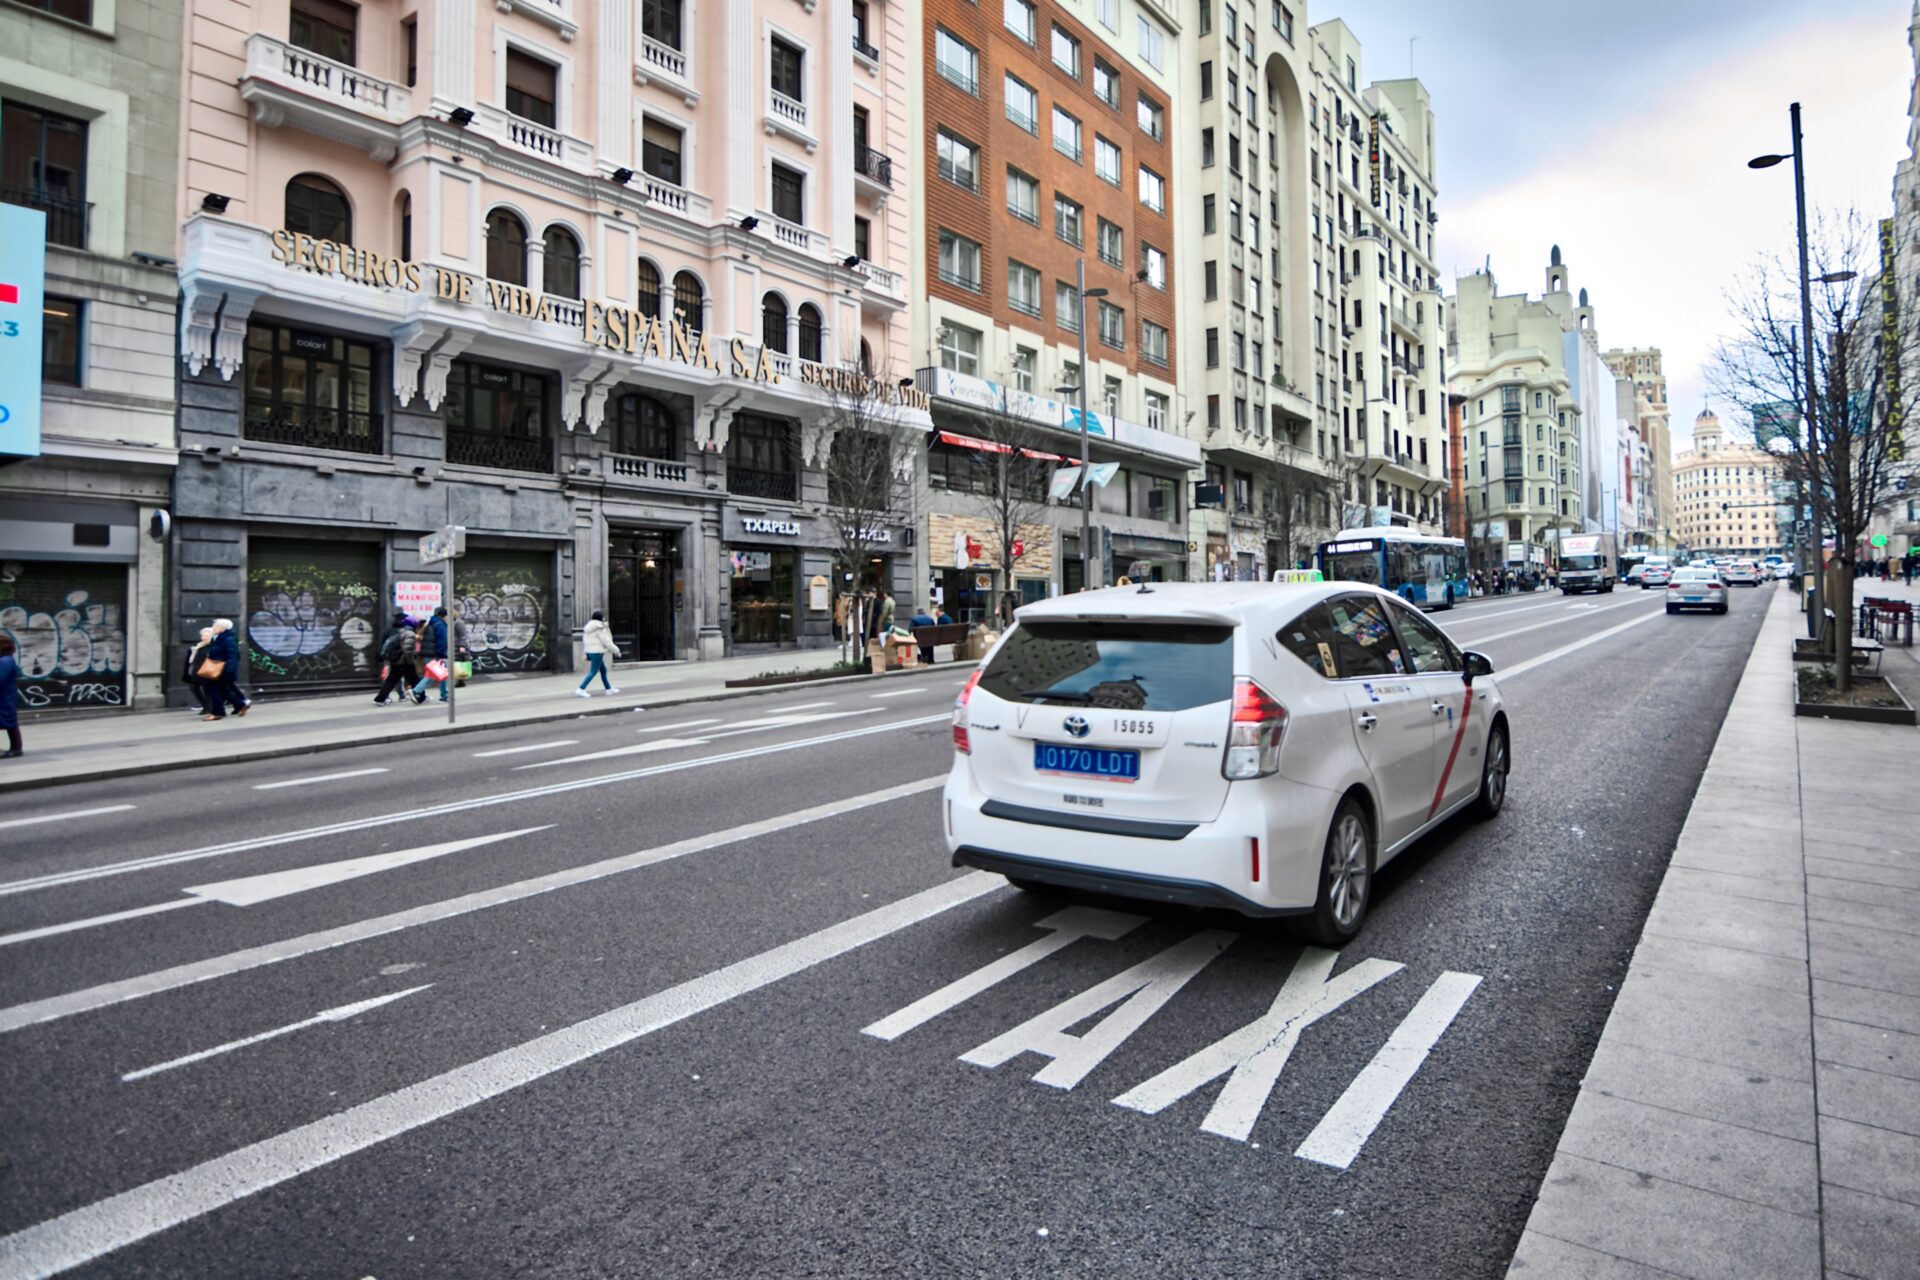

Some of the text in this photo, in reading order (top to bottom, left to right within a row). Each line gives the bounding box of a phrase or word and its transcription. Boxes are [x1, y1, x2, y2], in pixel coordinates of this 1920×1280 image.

[1880, 219, 1896, 302] HOTEL
[271, 229, 931, 412] SEGUROS DE VIDA ESPAÑA, S.A. SEGUROS DE VIDA
[296, 339, 327, 350] colart
[743, 518, 801, 535] TXAPELA
[1796, 520, 1806, 532] P
[1112, 719, 1155, 734] 15055
[1046, 747, 1134, 775] 0170 LDT
[859, 906, 1484, 1170] TAXI
